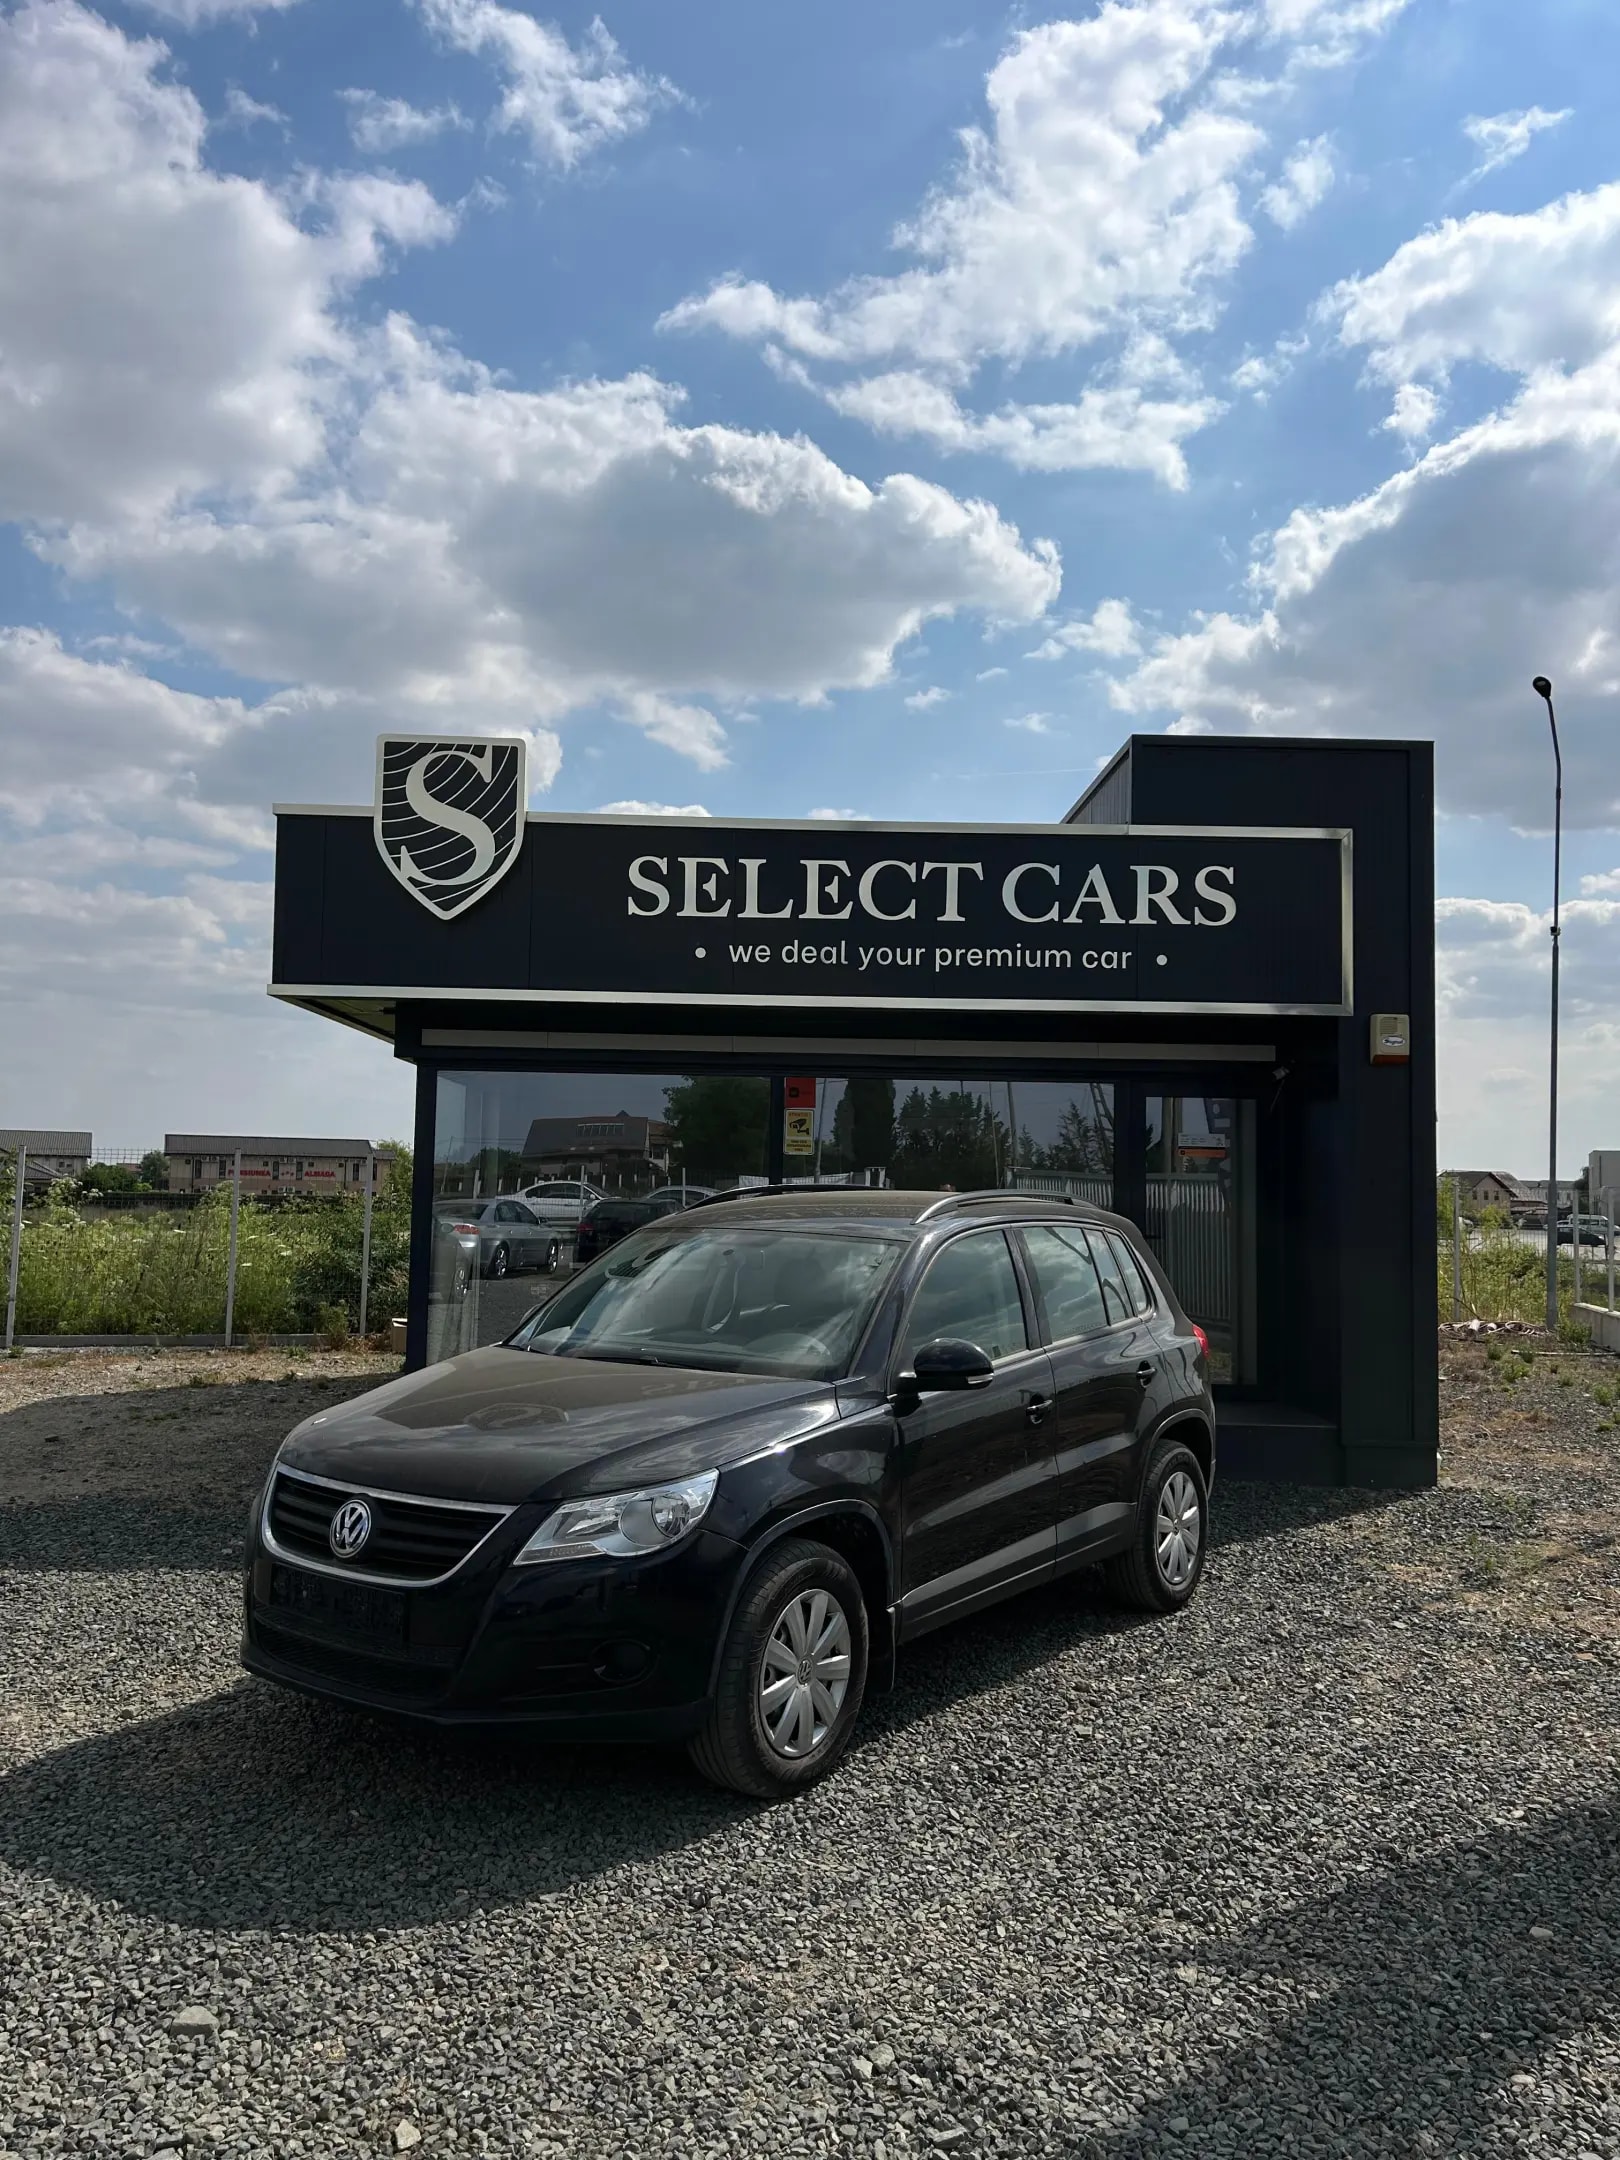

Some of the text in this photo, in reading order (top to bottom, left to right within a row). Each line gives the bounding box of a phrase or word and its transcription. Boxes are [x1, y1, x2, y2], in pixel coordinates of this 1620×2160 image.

[627, 855, 1238, 928] SELECT CARS
[728, 939, 1132, 973] we deal your premium car
